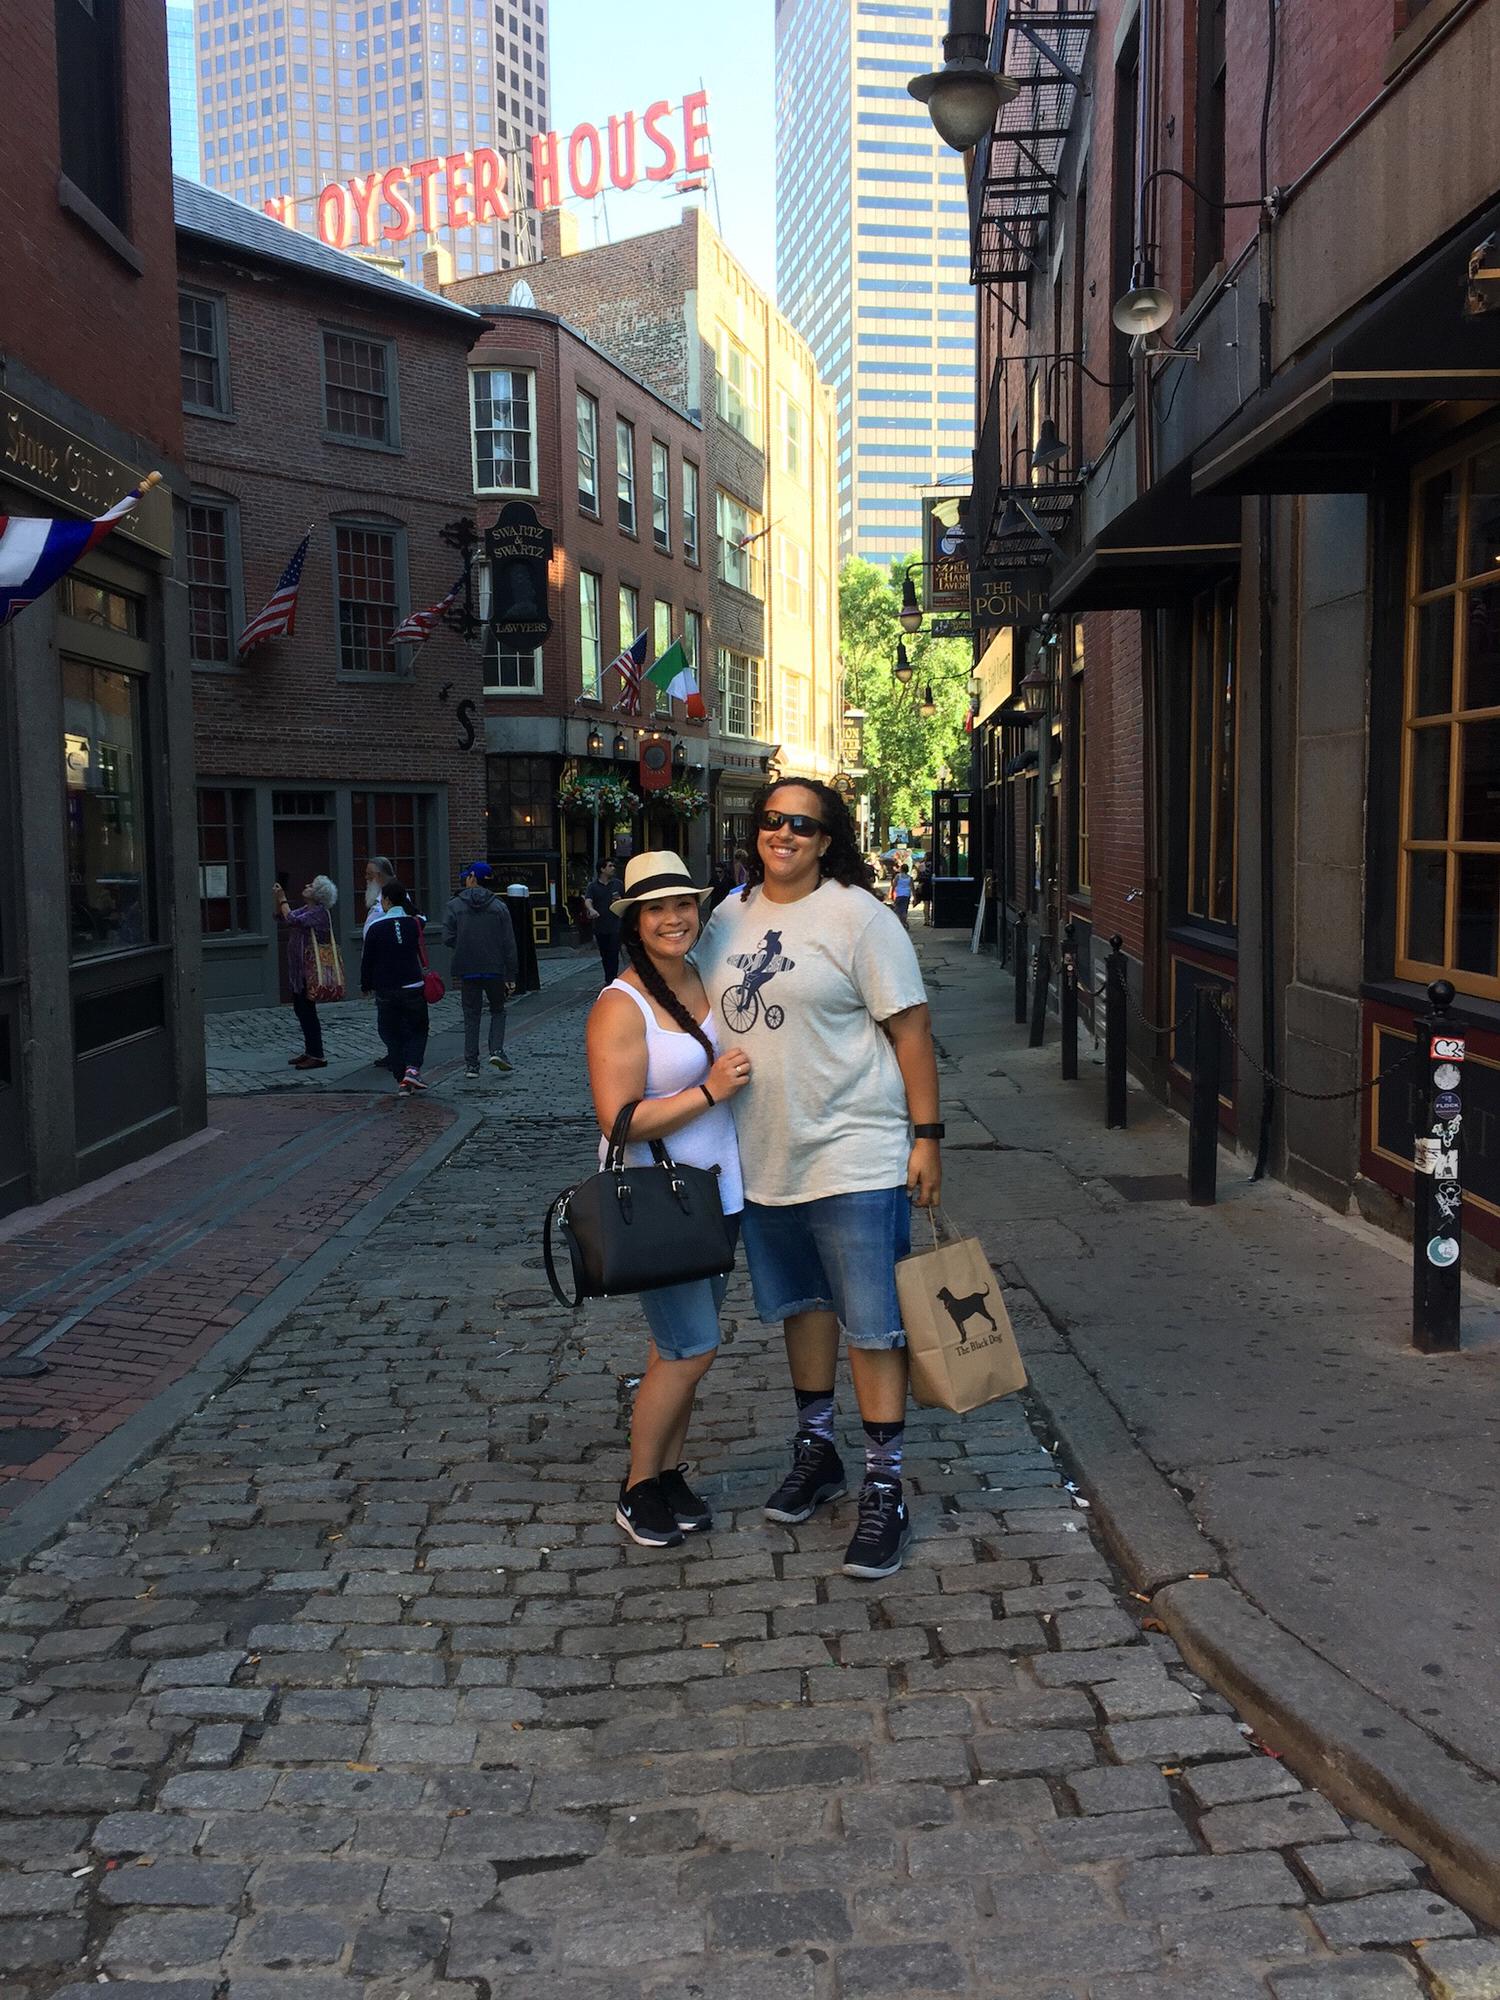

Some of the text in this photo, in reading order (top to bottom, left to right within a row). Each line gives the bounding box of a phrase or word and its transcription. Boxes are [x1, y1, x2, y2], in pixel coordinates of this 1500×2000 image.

[319, 90, 712, 249] OYSTER HOUSE
[492, 525, 545, 540] SWARTZ
[514, 536, 523, 545] &
[494, 544, 545, 558] SWARTZ
[982, 581, 1013, 595] THE
[975, 590, 1048, 618] POINT
[495, 623, 547, 633] LAWYERS
[955, 1333, 1003, 1356] The Black Dog
